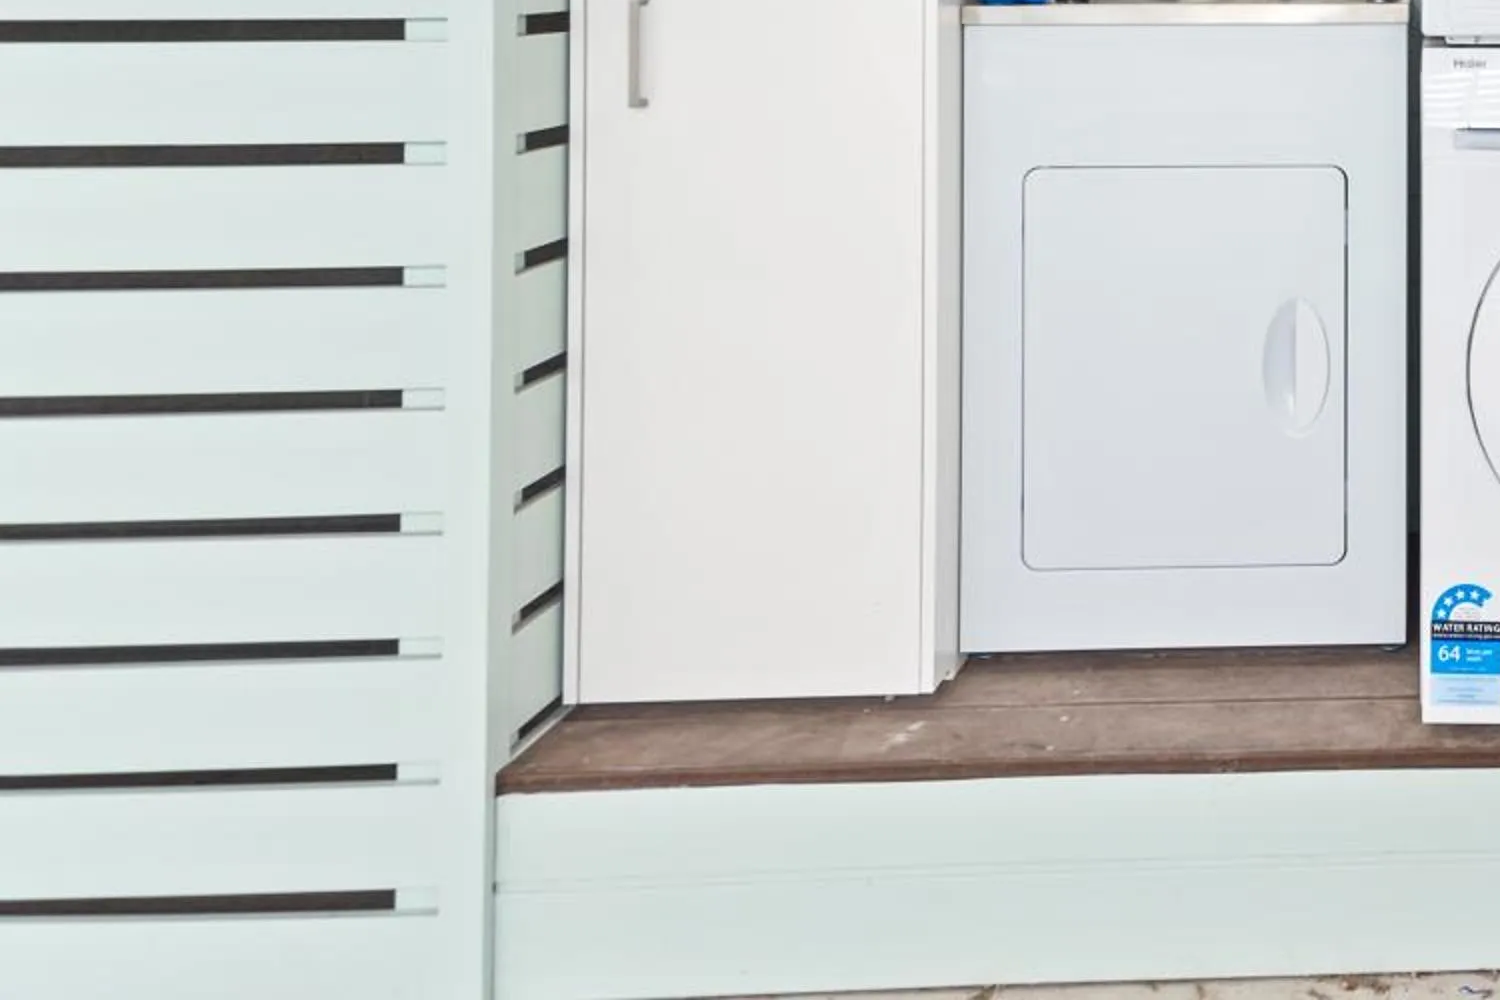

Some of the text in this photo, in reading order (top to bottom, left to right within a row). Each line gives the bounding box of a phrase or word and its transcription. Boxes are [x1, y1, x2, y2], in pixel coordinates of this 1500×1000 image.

[1433, 623, 1500, 633] WATER RATING
[1437, 644, 1461, 662] 64
